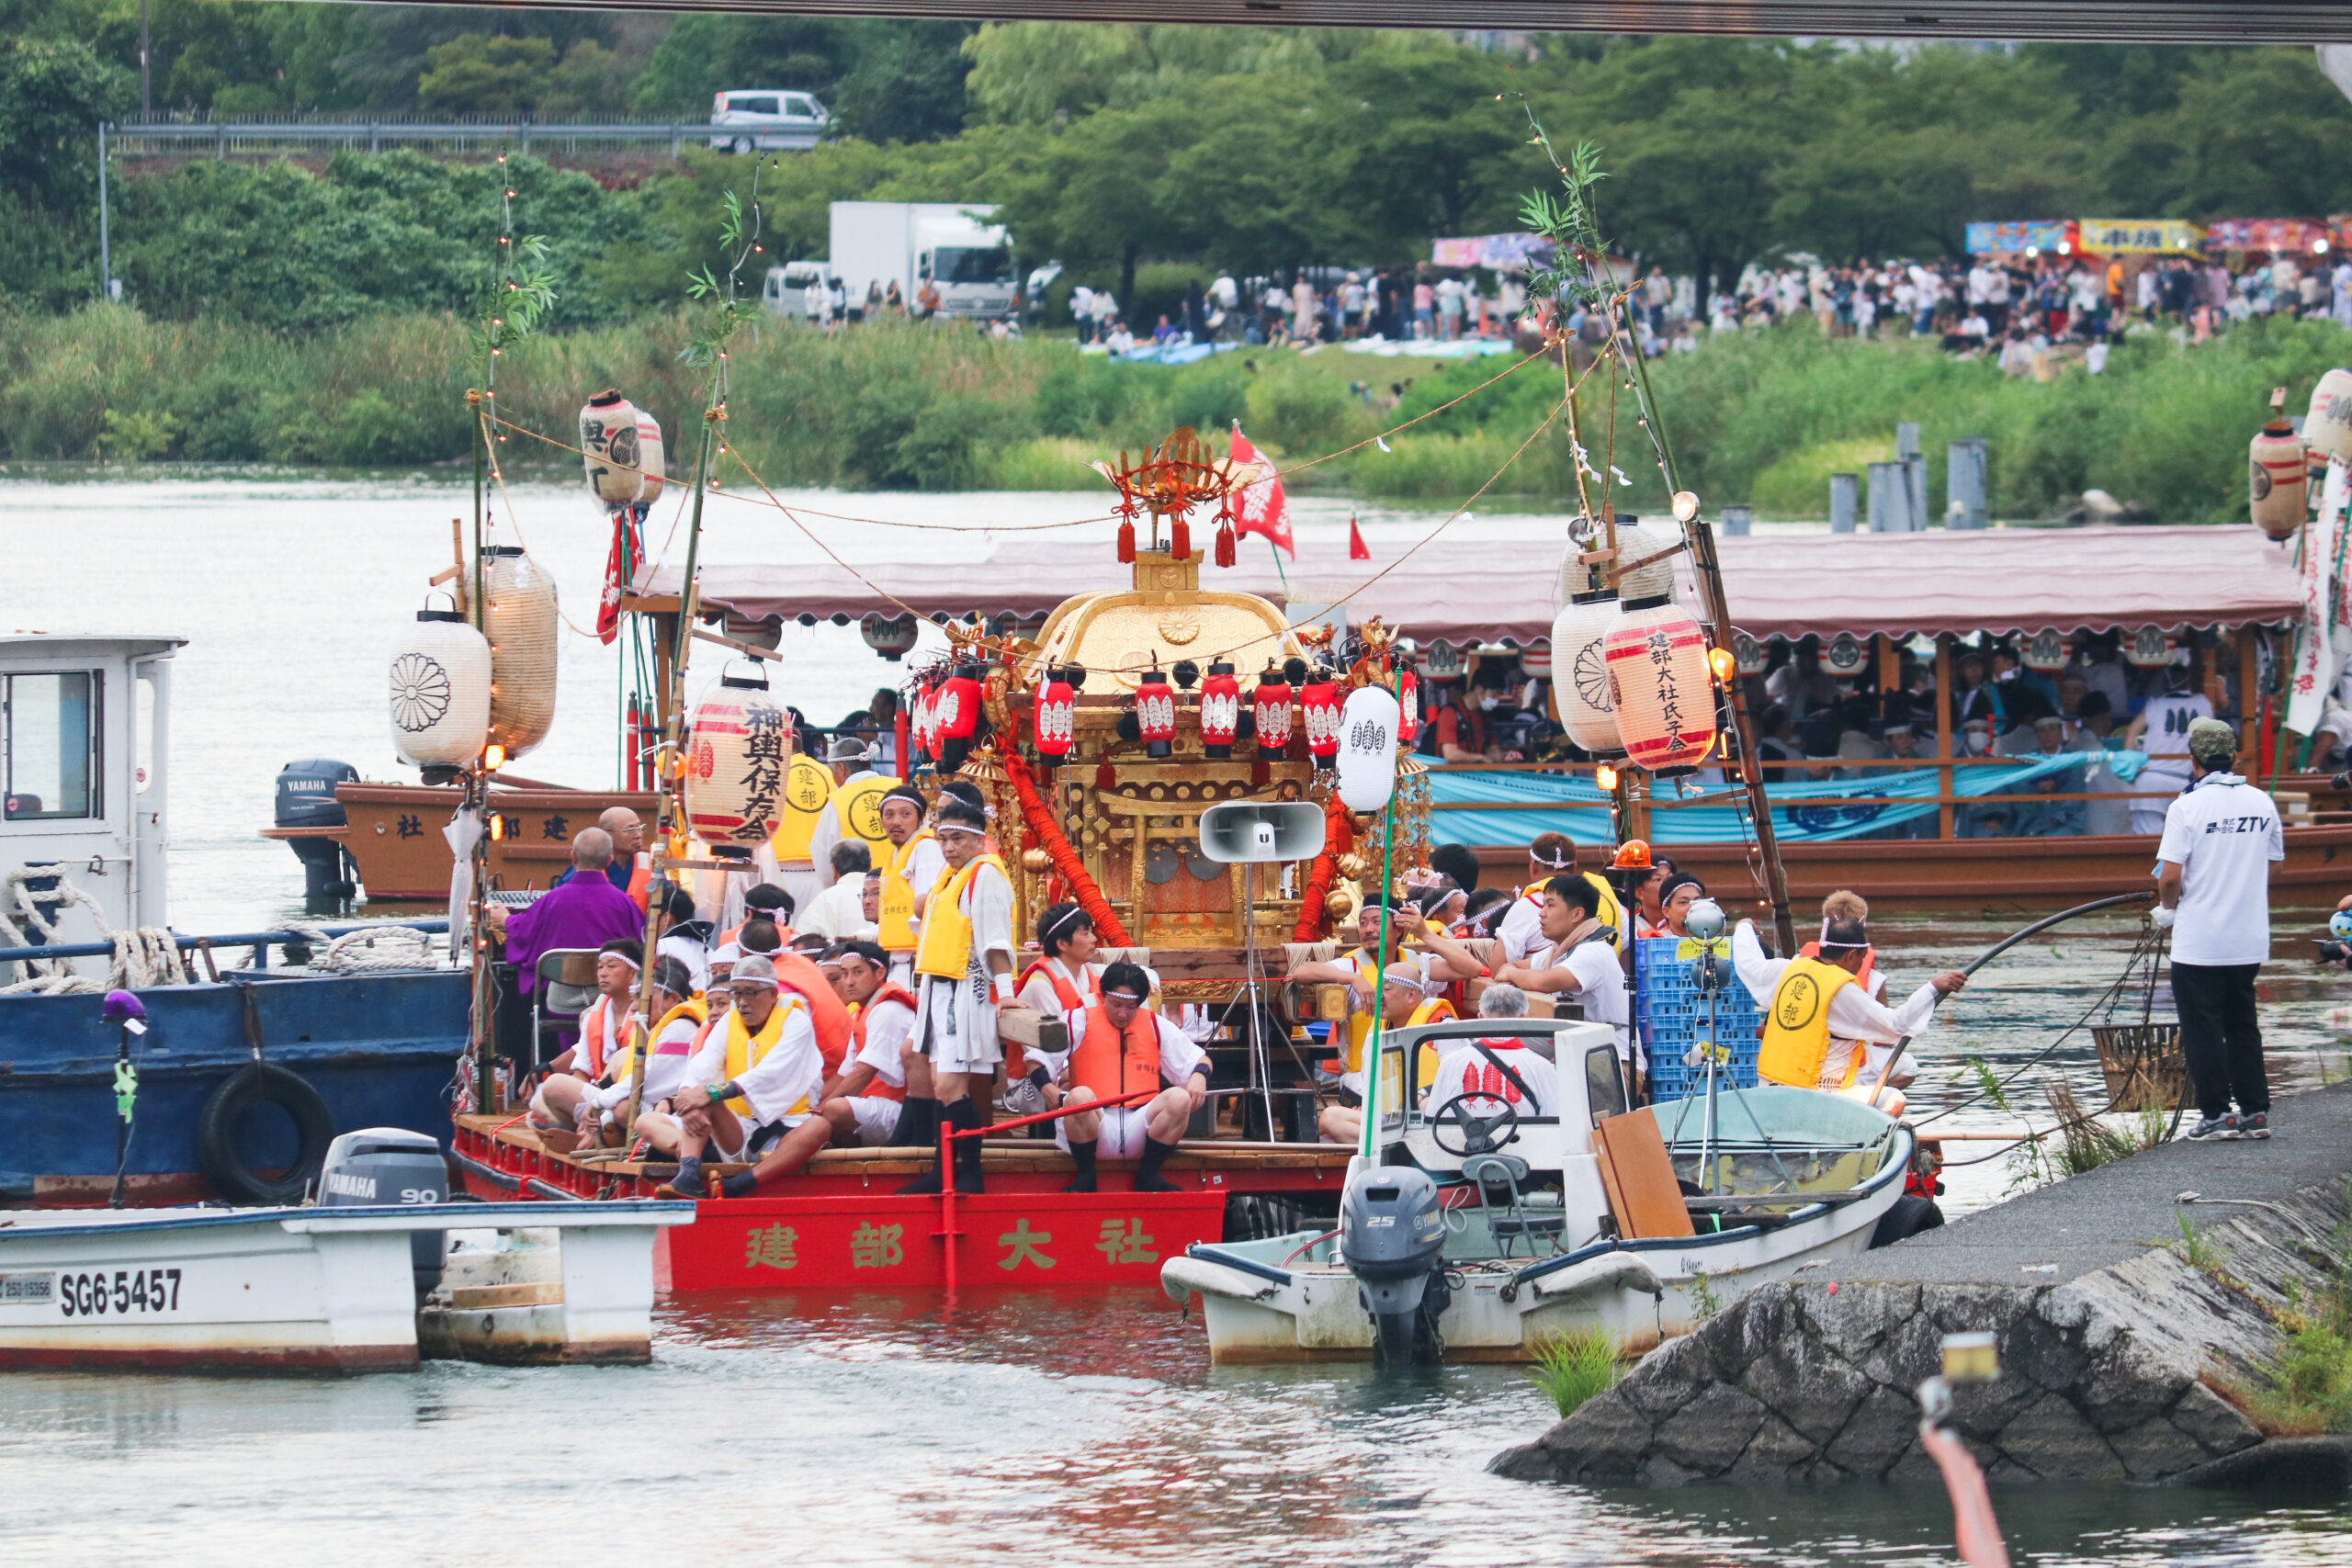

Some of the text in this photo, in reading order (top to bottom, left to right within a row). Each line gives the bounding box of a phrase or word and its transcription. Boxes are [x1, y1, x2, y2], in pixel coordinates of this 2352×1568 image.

[1648, 632, 1688, 750] 建部大社氏子会
[288, 781, 326, 792] YAMAHA
[729, 702, 784, 840] 神輿保存会
[798, 768, 817, 807] 建部
[2235, 816, 2270, 833] ZTV
[1782, 980, 1807, 1024] 建部
[328, 1173, 438, 1204] YAMAHA 90
[1366, 1215, 1396, 1228] 25
[744, 1217, 1159, 1270] 建部大社
